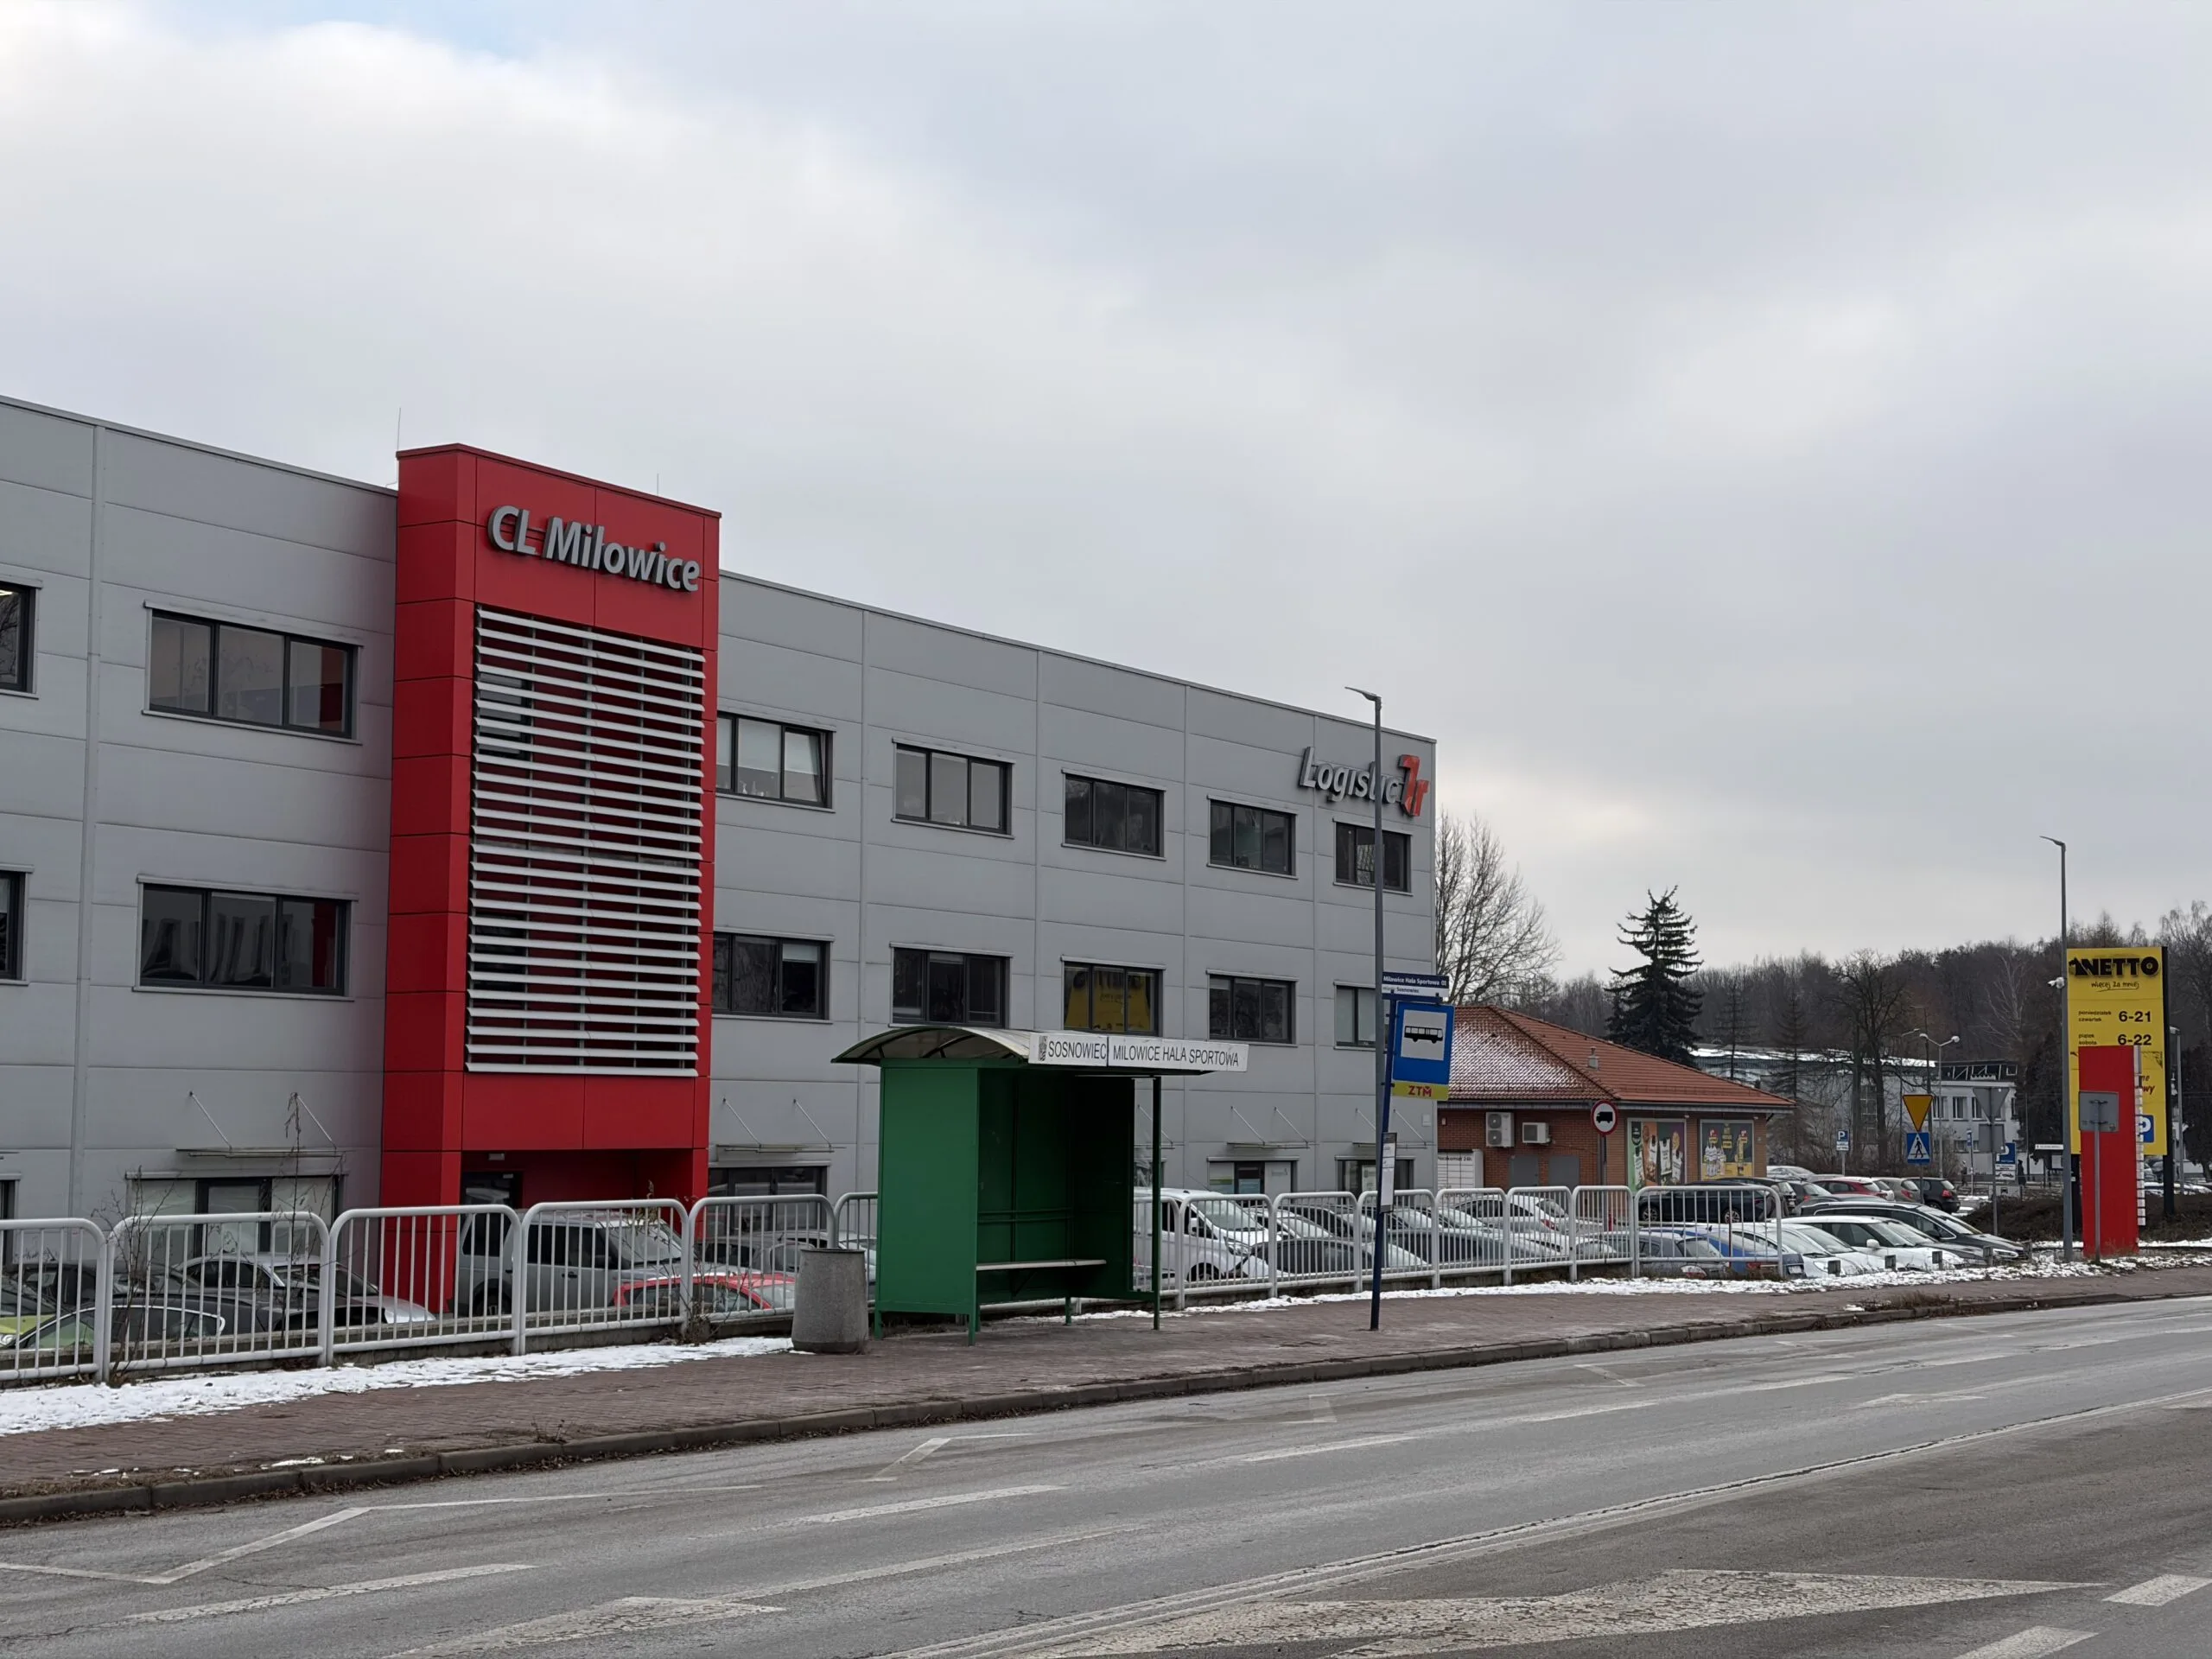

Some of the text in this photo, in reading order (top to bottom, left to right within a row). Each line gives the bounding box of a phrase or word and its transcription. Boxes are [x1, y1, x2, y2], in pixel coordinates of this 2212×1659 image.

[488, 505, 700, 592] CL Milowice
[2075, 957, 2159, 976] NETTO
[2119, 1010, 2151, 1022] 6-21
[2117, 1033, 2152, 1046] 6-22
[1048, 1039, 1239, 1067] SOSNOWIEC MILOWICE HALA SPORTOWA
[1408, 1084, 1433, 1097] ZTM
[1838, 1130, 1846, 1141] P
